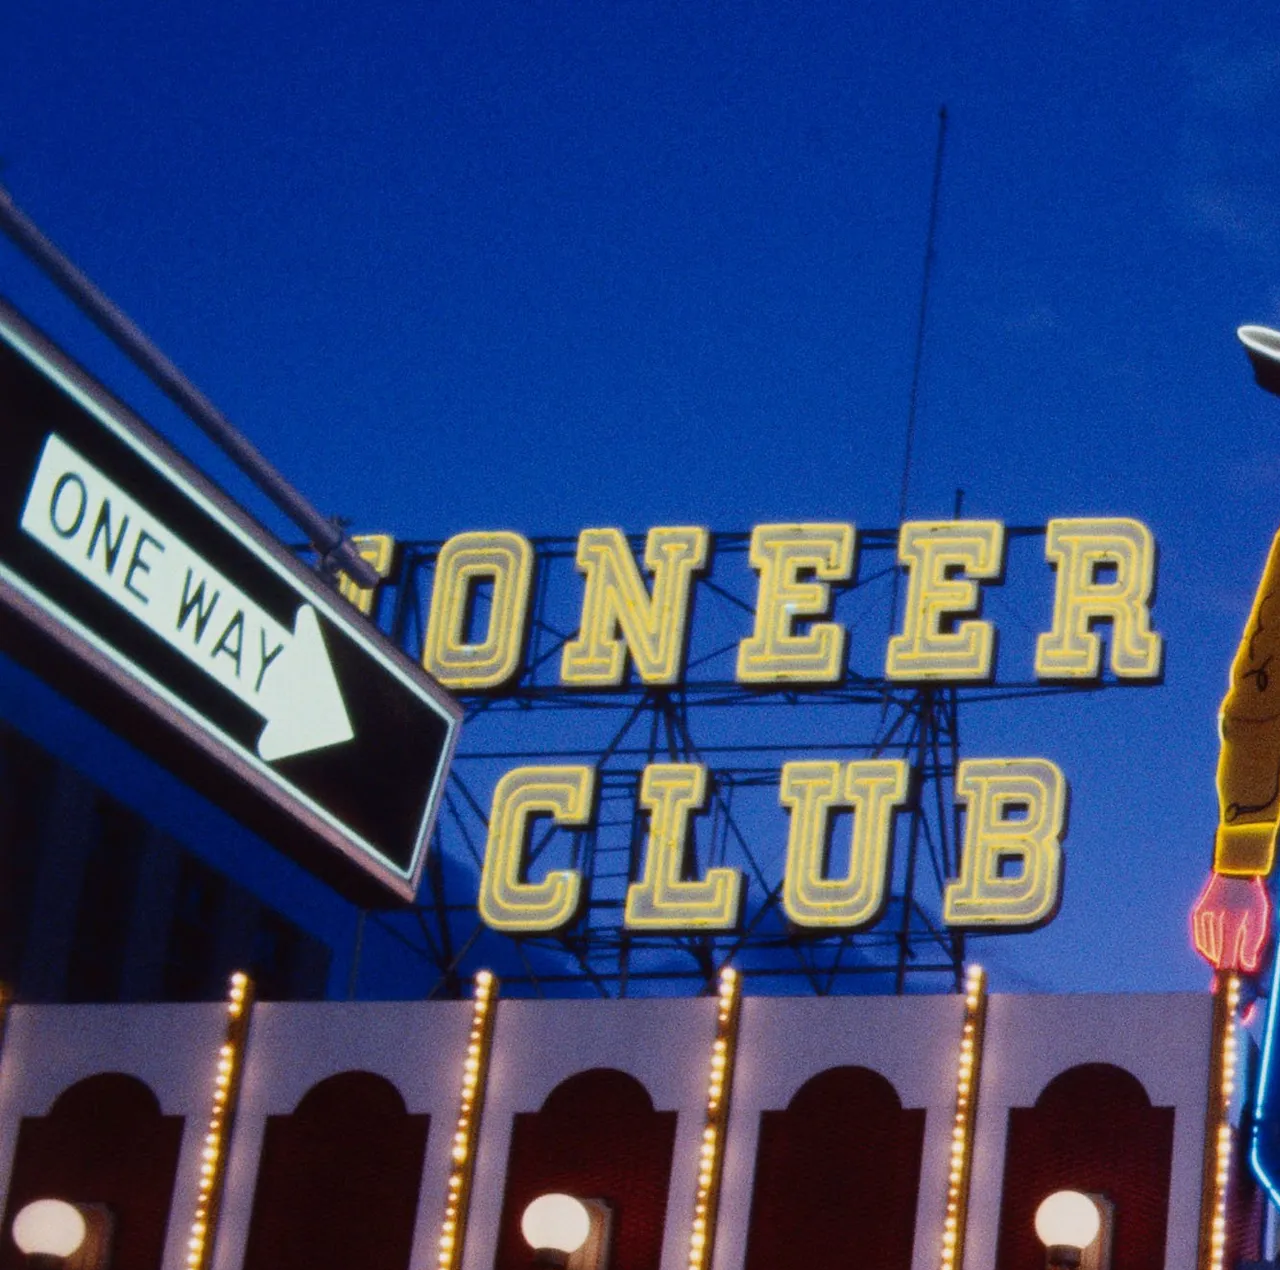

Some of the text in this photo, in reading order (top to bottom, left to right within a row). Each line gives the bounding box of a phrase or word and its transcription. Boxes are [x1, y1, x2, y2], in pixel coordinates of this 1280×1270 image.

[48, 471, 285, 695] ONE WAY
[478, 758, 1067, 933] CLUB
